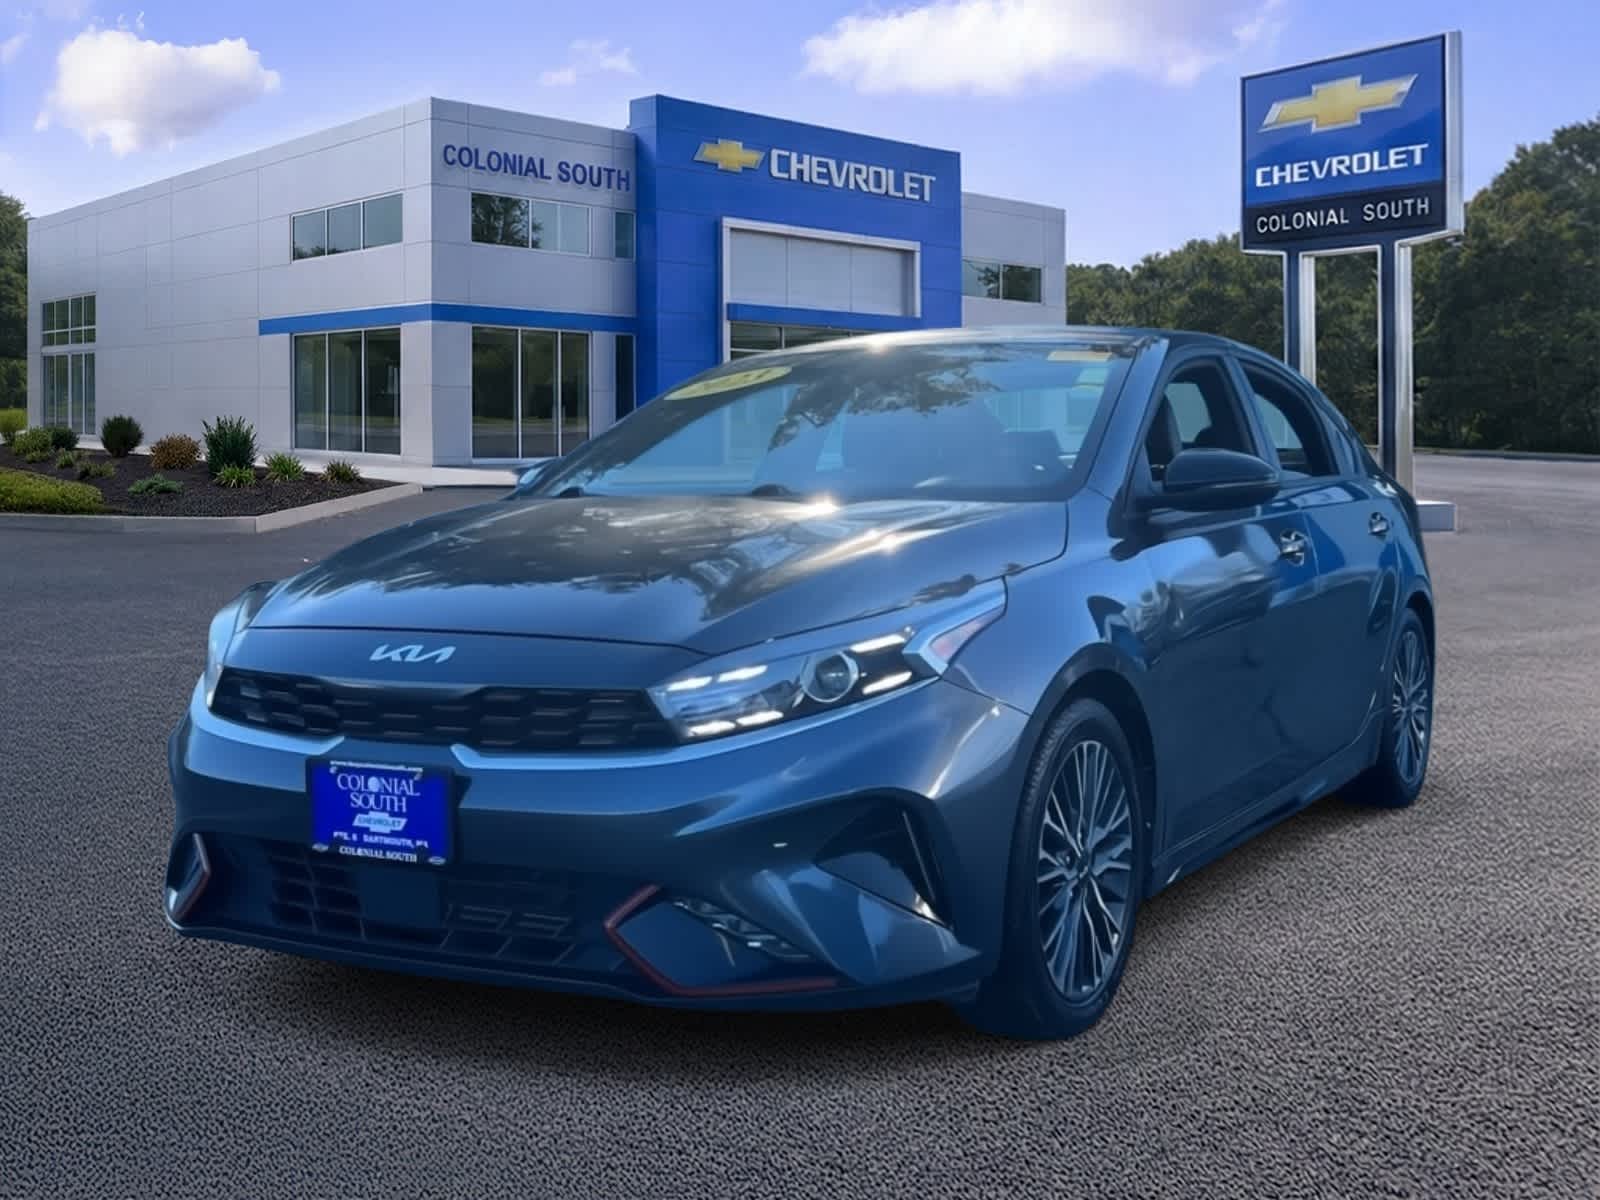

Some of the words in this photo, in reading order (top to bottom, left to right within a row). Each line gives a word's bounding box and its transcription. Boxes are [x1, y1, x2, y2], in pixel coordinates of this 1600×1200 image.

[443, 144, 552, 180] COLONIAL
[557, 160, 631, 192] SOUTH
[770, 148, 936, 202] CHEVROLET
[1255, 143, 1429, 187] CHEVROLET
[1256, 207, 1349, 233] COLONIAL
[1363, 197, 1430, 221] SOUTH
[337, 773, 421, 796] COLONIAL
[350, 791, 407, 813] SOUTH
[339, 845, 384, 860] COLONIAL
[386, 850, 418, 863] SOUTH
